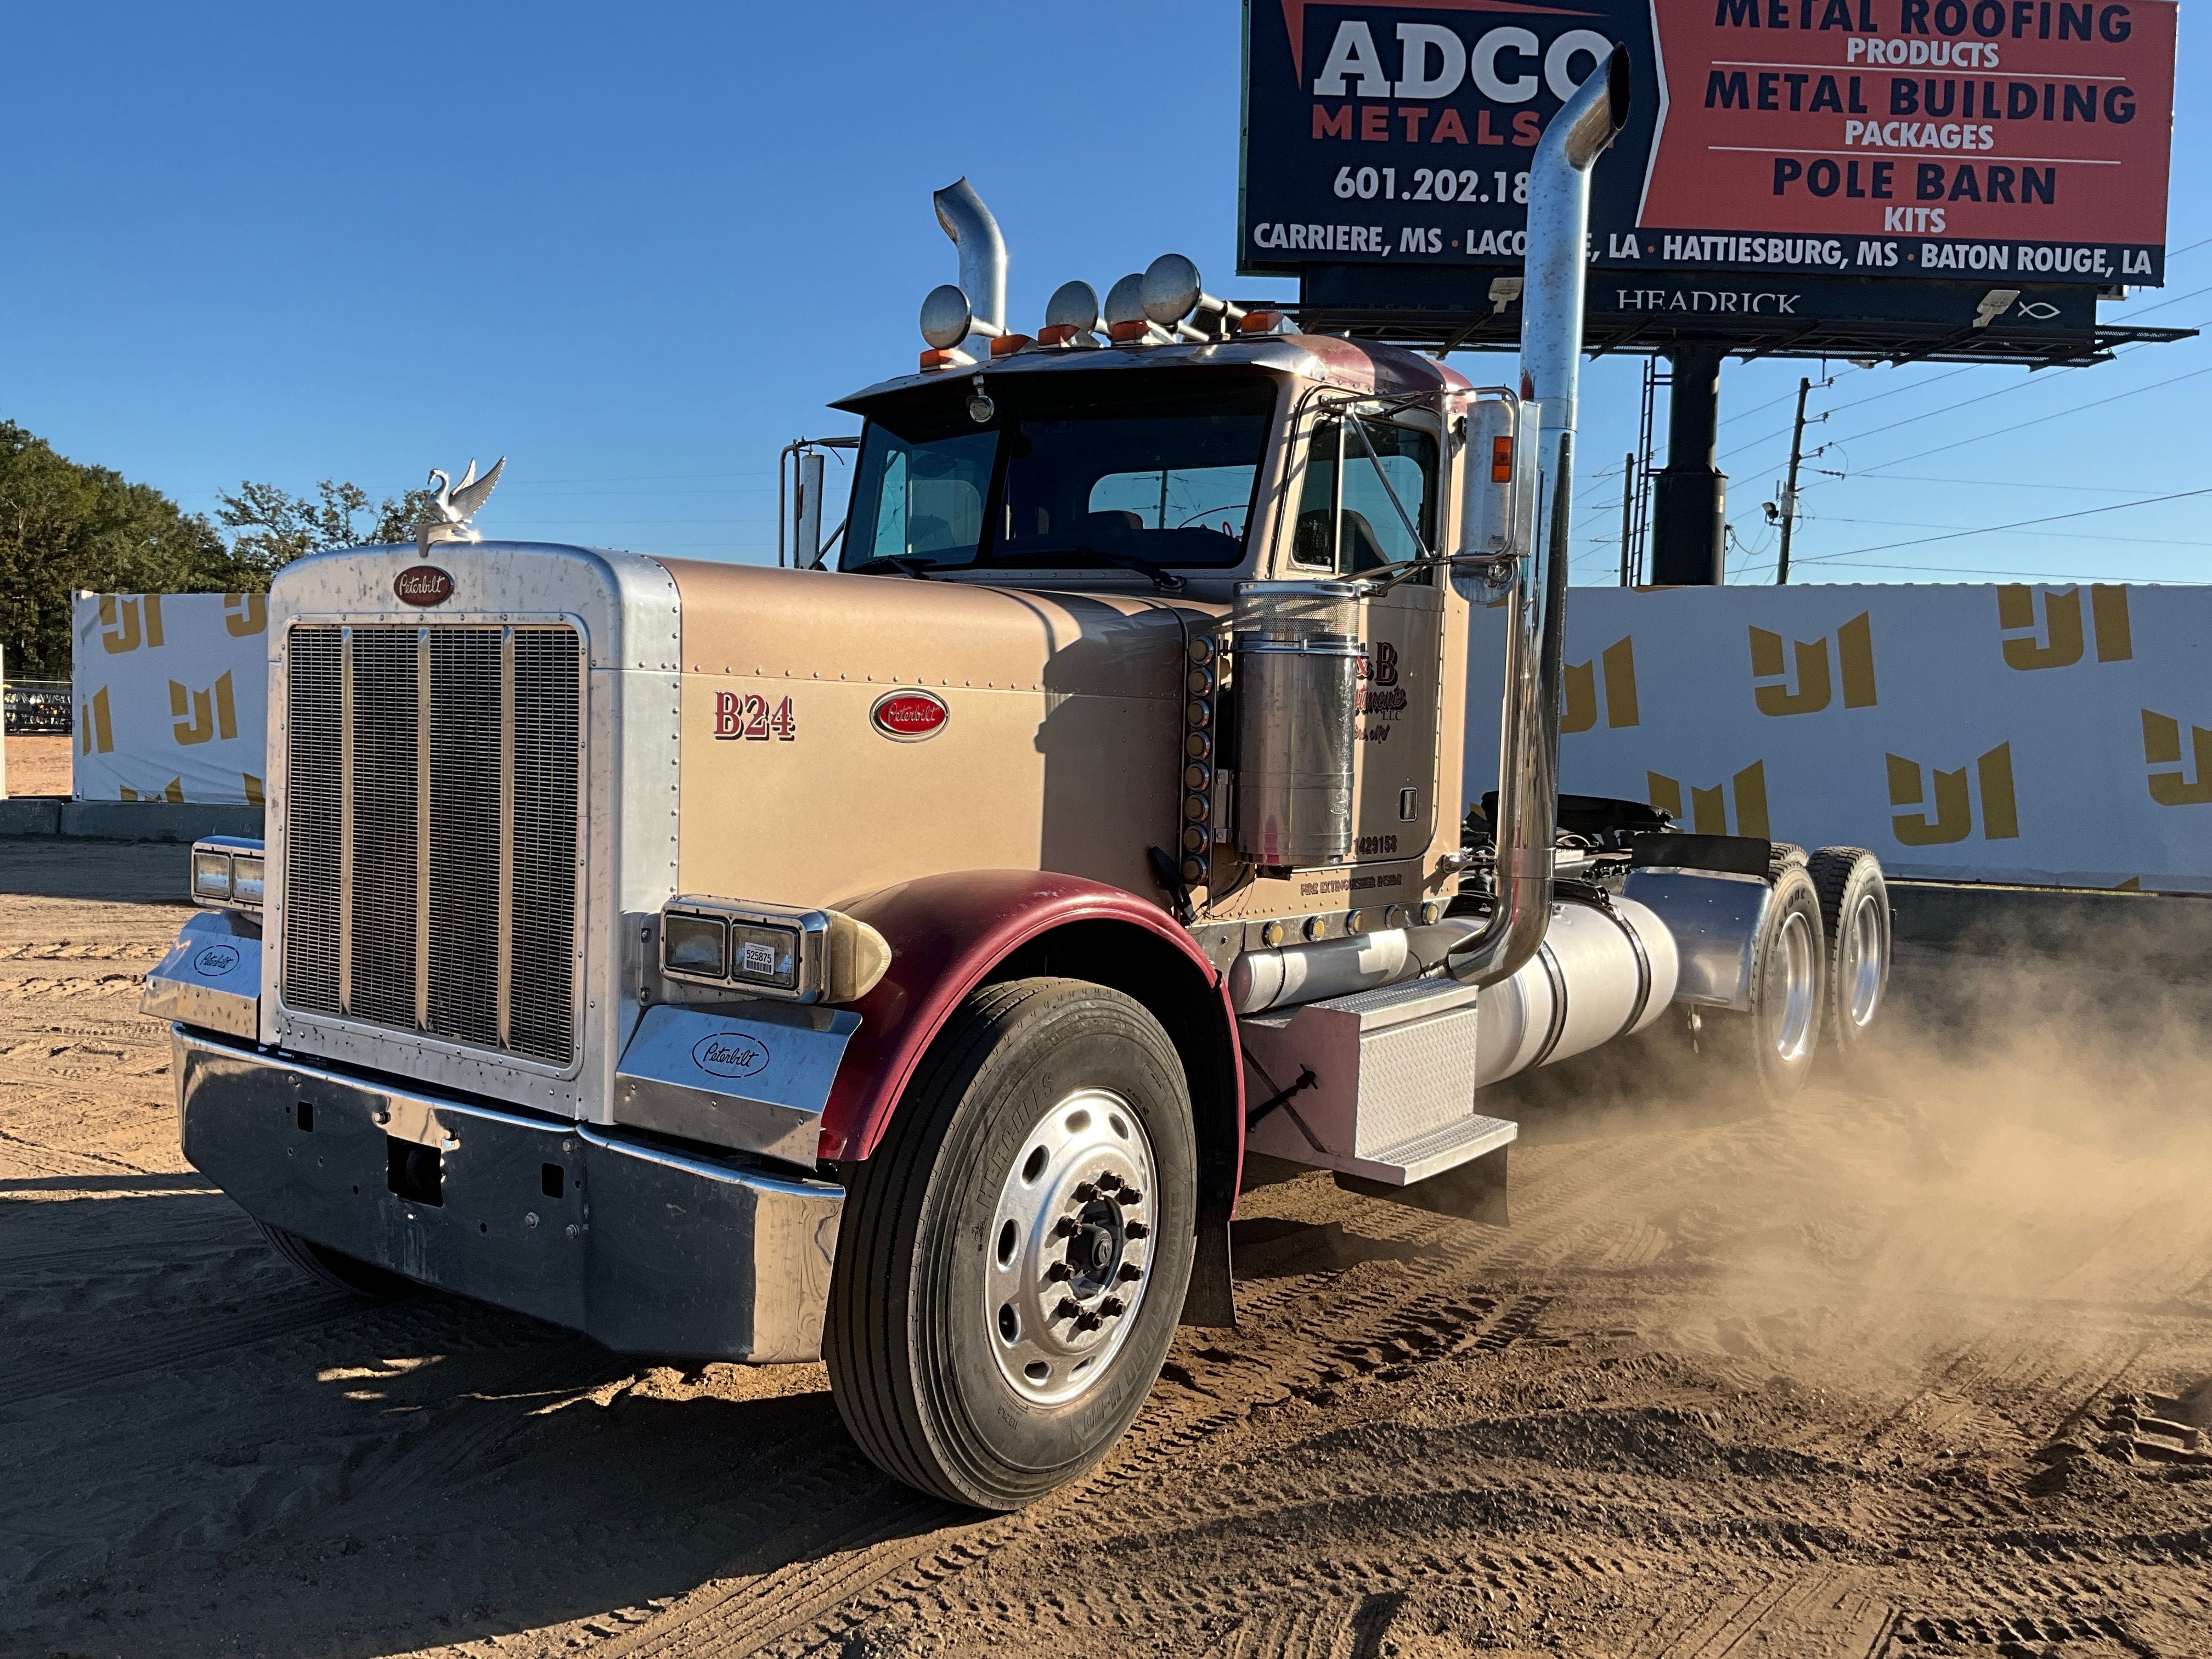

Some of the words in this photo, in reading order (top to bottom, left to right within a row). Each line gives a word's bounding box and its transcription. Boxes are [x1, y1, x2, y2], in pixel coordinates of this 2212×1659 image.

[1715, 0, 1878, 32] METAL
[1900, 0, 2132, 43] ROOFING
[1313, 20, 1615, 104] ADCO
[1847, 37, 2000, 68] PRODUCTS
[1705, 70, 1869, 114] METAL
[1889, 76, 2137, 125] BUILDING
[1845, 120, 1994, 150] PACKAGES
[1333, 166, 1531, 205] 601.202.18
[1773, 157, 1894, 199] POLE
[1916, 162, 2056, 205] BARN
[1884, 205, 1946, 234] KITS
[1253, 223, 1392, 257] CARRIERE,
[1399, 227, 1443, 253] MS
[1609, 233, 1640, 259] LA
[1663, 235, 1849, 270] HATTIESBURG,
[1856, 241, 1899, 267] MS
[1921, 242, 2009, 270] BATON
[2017, 246, 2114, 278] ROUGE,
[2122, 249, 2152, 274] LA
[1616, 289, 1802, 314] HEADRICK
[398, 573, 446, 596] Peterbilt
[1374, 641, 1398, 687] B
[712, 690, 796, 742] B24
[887, 702, 941, 725] Peterbilt
[1382, 709, 1402, 721] LLC
[746, 949, 772, 964] 525875
[703, 1040, 760, 1068] Peterbilt
